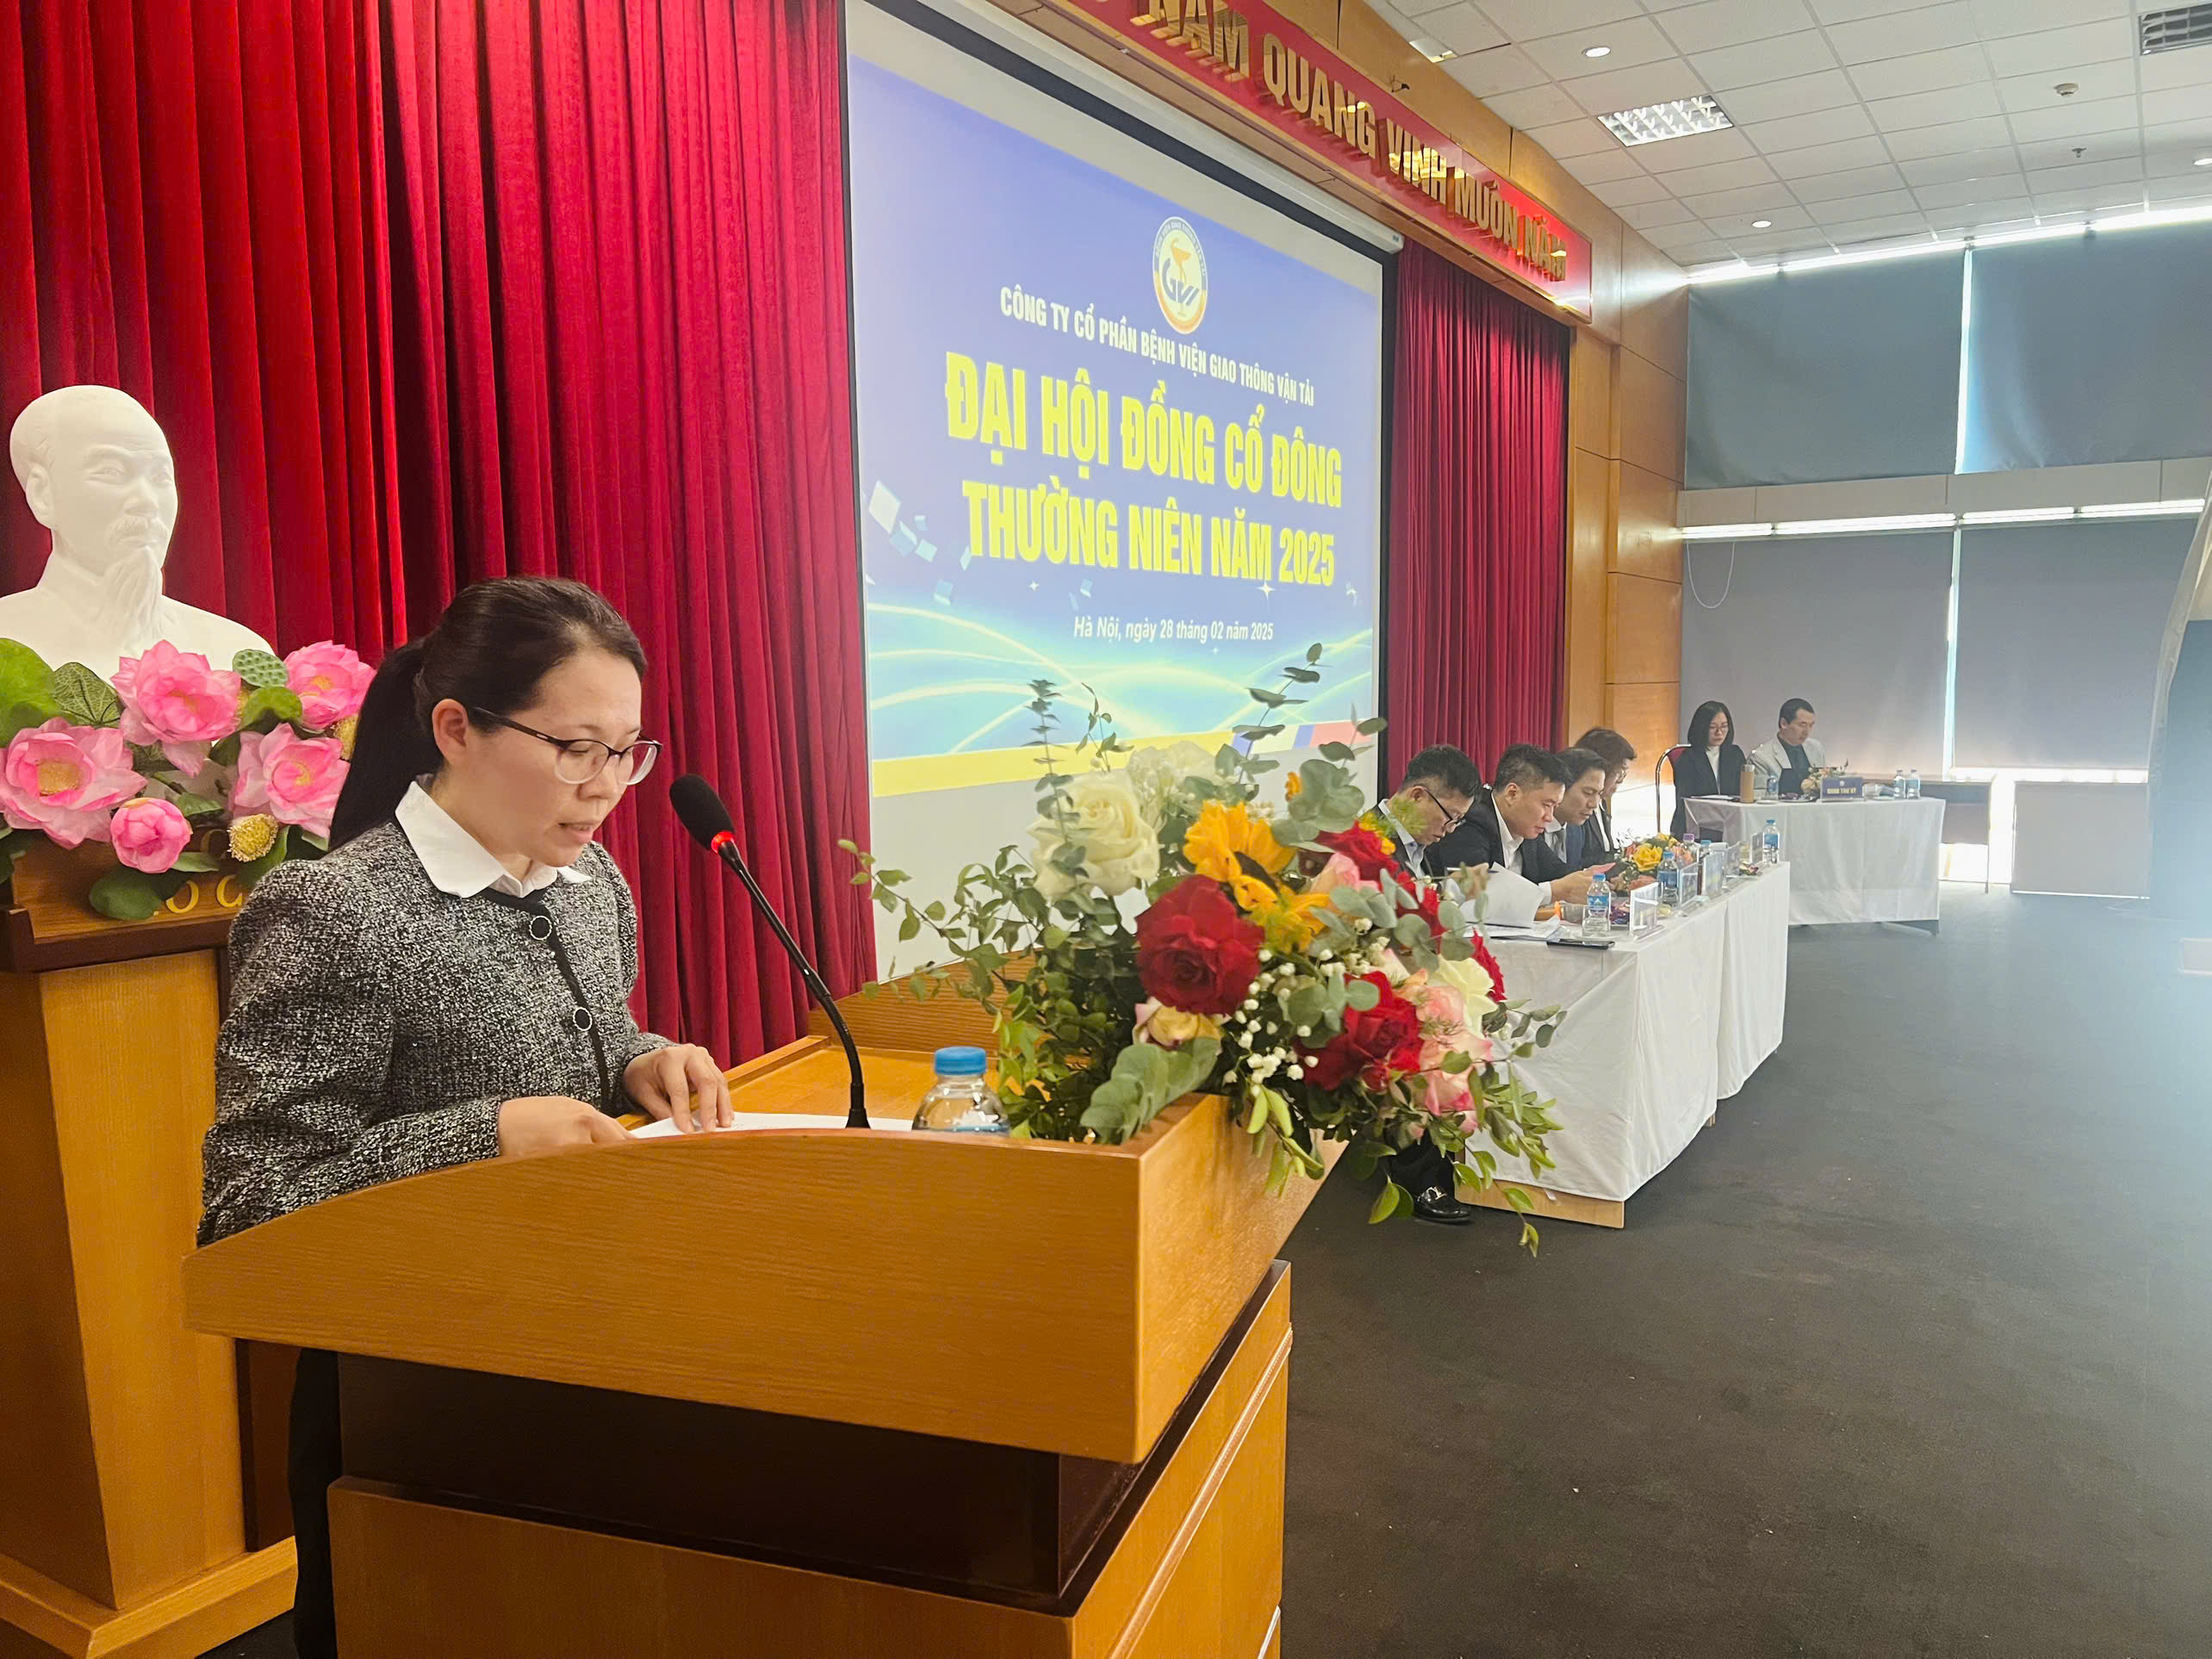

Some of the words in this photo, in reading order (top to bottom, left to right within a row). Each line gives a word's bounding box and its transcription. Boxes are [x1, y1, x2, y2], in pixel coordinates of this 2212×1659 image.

[1263, 33, 1376, 158] QUANG
[1387, 117, 1447, 206] VINH
[1454, 165, 1519, 252] MUÔN
[1000, 283, 1047, 326] CÔNG
[1050, 302, 1070, 332] TY
[1074, 302, 1096, 341] CỔ
[1140, 328, 1176, 365] BỆNH
[1178, 342, 1207, 377] VIỆN
[1209, 353, 1237, 384] GIAO
[1239, 362, 1275, 395] THÔNG
[1277, 372, 1297, 404] VẬN
[1299, 378, 1314, 407] TẢI
[945, 351, 1028, 466] ĐẠI
[1041, 367, 1109, 480] HỘI
[1121, 379, 1215, 485] ĐỒNG
[1224, 403, 1265, 494] CỔ
[1271, 426, 1342, 508] ĐÔNG
[962, 475, 1119, 569] THƯỜNG
[1128, 496, 1202, 575] NIÊN
[1210, 506, 1272, 581] NĂM
[1278, 527, 1336, 587] 2025
[1074, 615, 1093, 637] Hà
[1097, 616, 1122, 643] Nội,
[1125, 617, 1158, 643] ngày
[1159, 618, 1174, 639] 28
[1176, 619, 1208, 643] tháng
[1210, 621, 1224, 639] 02
[1226, 620, 1249, 640] năm
[1251, 622, 1275, 641] 2025
